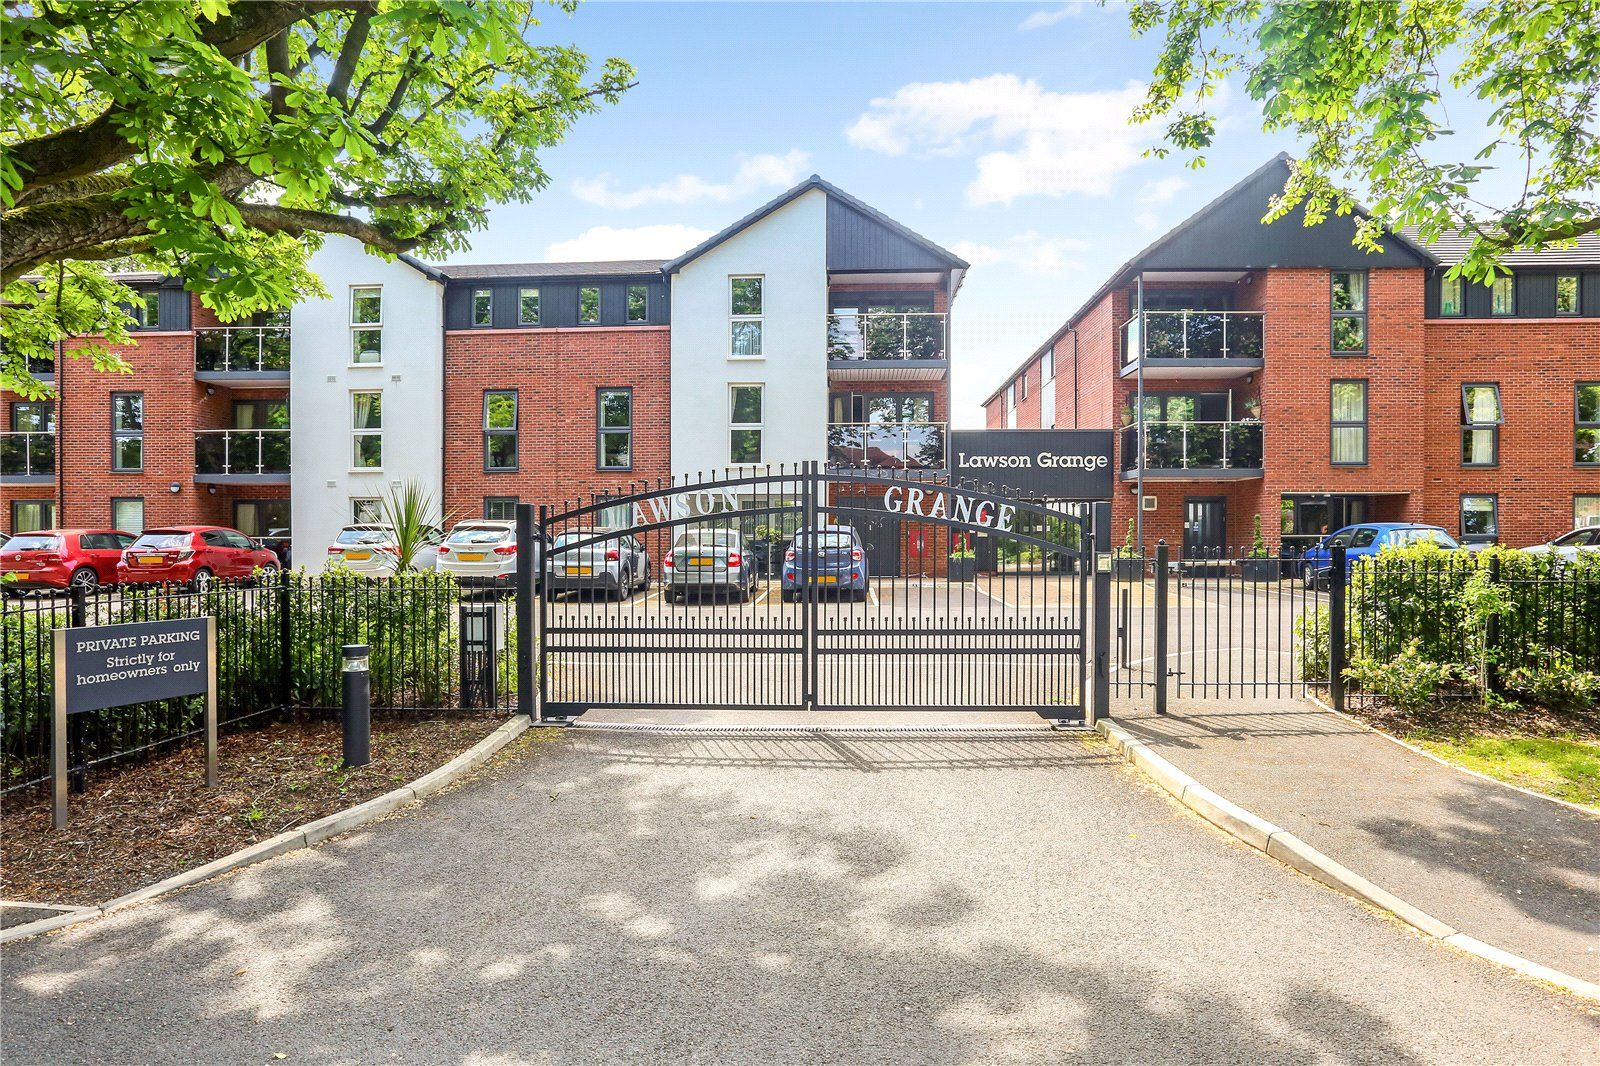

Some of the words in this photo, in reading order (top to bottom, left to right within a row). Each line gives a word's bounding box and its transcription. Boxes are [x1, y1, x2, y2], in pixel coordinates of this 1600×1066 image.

[958, 452, 1031, 468] Lawson
[1037, 452, 1108, 471] Grange
[884, 486, 1016, 532] GRANGE
[76, 636, 137, 653] PRIVATE
[140, 630, 200, 646] PARKING
[106, 653, 154, 668] Strictly
[158, 651, 175, 662] for
[76, 665, 167, 685] homeowners
[173, 660, 200, 672] only
